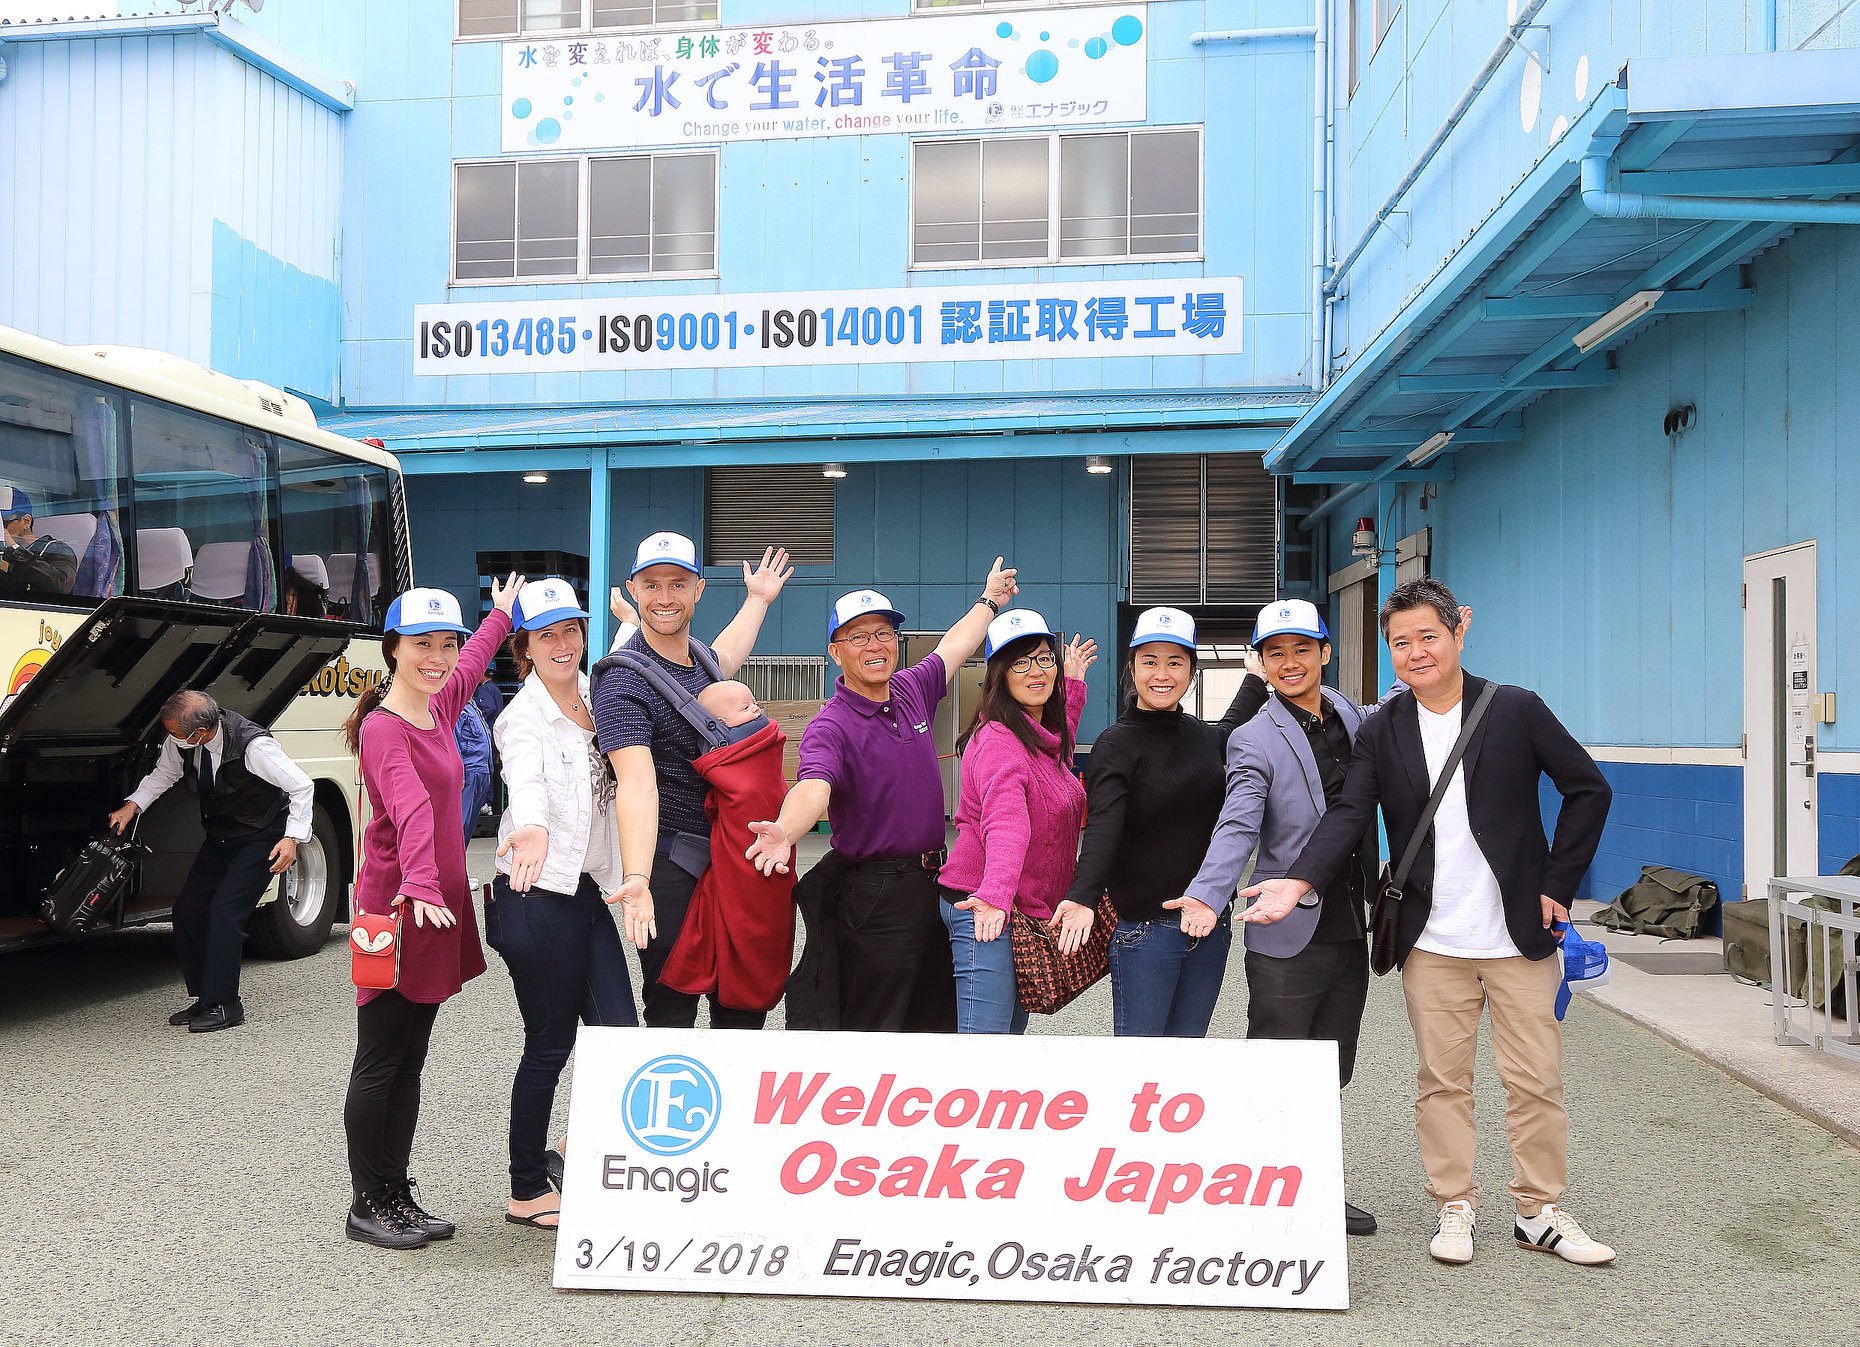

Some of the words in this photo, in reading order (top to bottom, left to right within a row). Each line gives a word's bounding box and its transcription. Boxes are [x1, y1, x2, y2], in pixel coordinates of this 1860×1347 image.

[518, 30, 834, 69] 水を変えれば、身体が変わる。
[632, 47, 1003, 117] 水で生活革命
[683, 121, 740, 137] Change
[745, 120, 779, 134] your
[783, 117, 831, 132] water,
[835, 113, 891, 129] change
[896, 113, 931, 126] your
[934, 109, 964, 124] life.
[1026, 100, 1108, 118] エナジック
[940, 292, 1227, 345] 認証取得工場
[39, 619, 62, 651] joy
[753, 1071, 1089, 1130] Welcome
[1129, 1082, 1205, 1133] to
[602, 1154, 730, 1202] Enagic
[780, 1140, 1025, 1200] Osaka
[1064, 1147, 1303, 1215] Japan
[1150, 1247, 1325, 1296] factory
